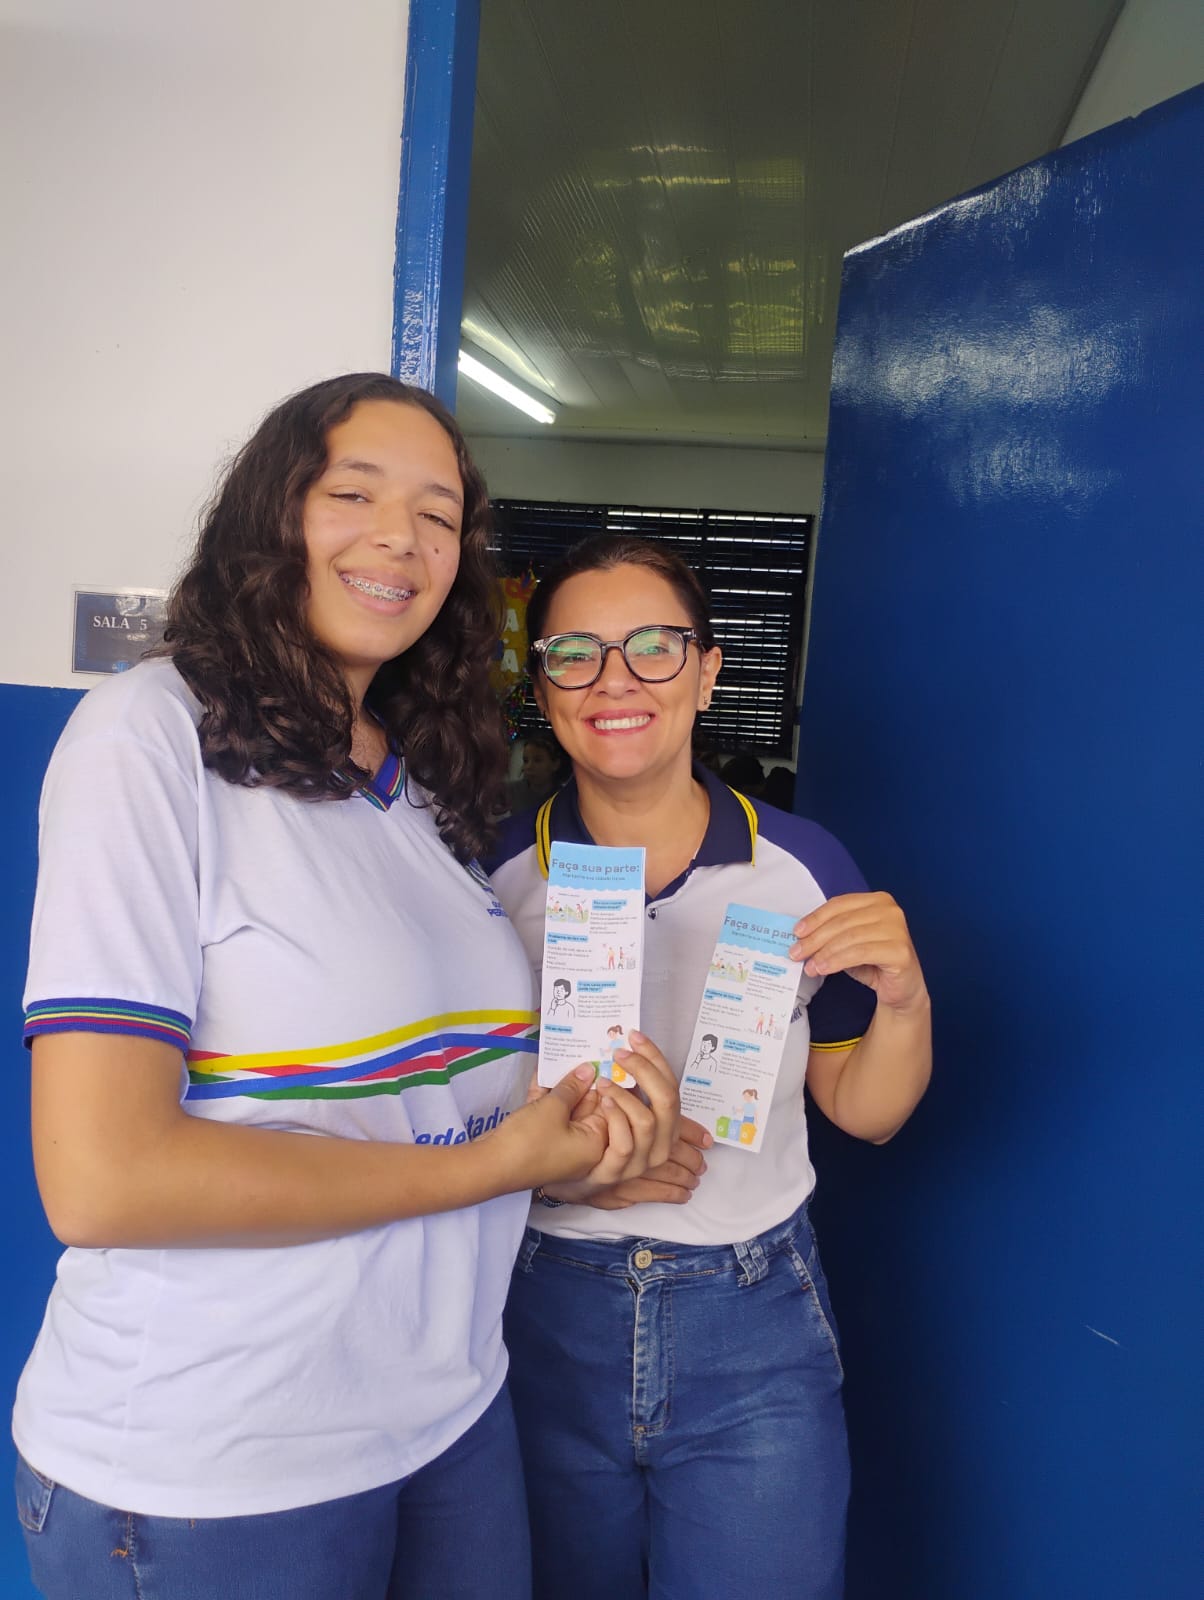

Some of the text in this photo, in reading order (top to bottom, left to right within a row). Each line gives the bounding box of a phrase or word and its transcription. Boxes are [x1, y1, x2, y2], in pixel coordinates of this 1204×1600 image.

[93, 615, 148, 631] SALA 5
[551, 858, 640, 876] Faça sua parte:
[723, 915, 798, 942] Faça sua part
[412, 1127, 466, 1145] ede
